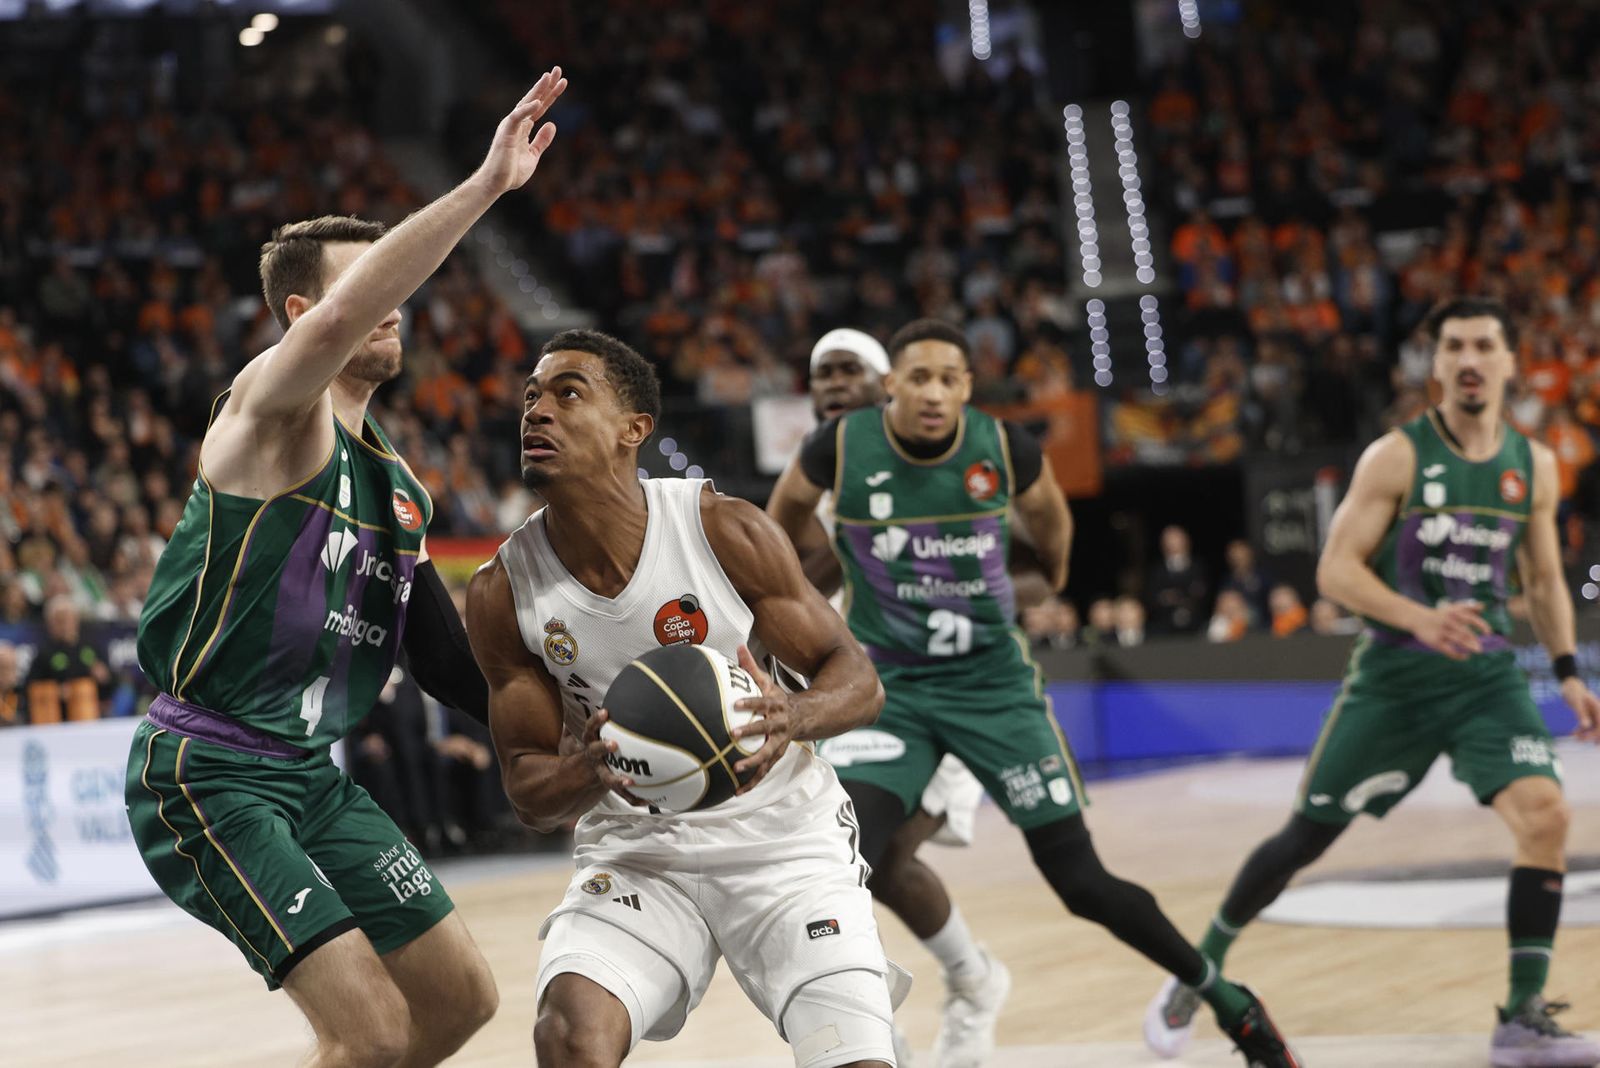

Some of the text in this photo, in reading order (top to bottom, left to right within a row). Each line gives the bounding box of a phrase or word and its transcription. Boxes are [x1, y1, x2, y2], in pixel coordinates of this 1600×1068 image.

[911, 531, 996, 560] Unicaja
[663, 620, 690, 632] Copa
[678, 627, 696, 638] Rey
[926, 609, 973, 657] 21
[299, 675, 331, 737] 4
[373, 844, 400, 872] sabor
[380, 871, 391, 882] a
[387, 865, 433, 904] laga
[810, 924, 835, 938] acb
